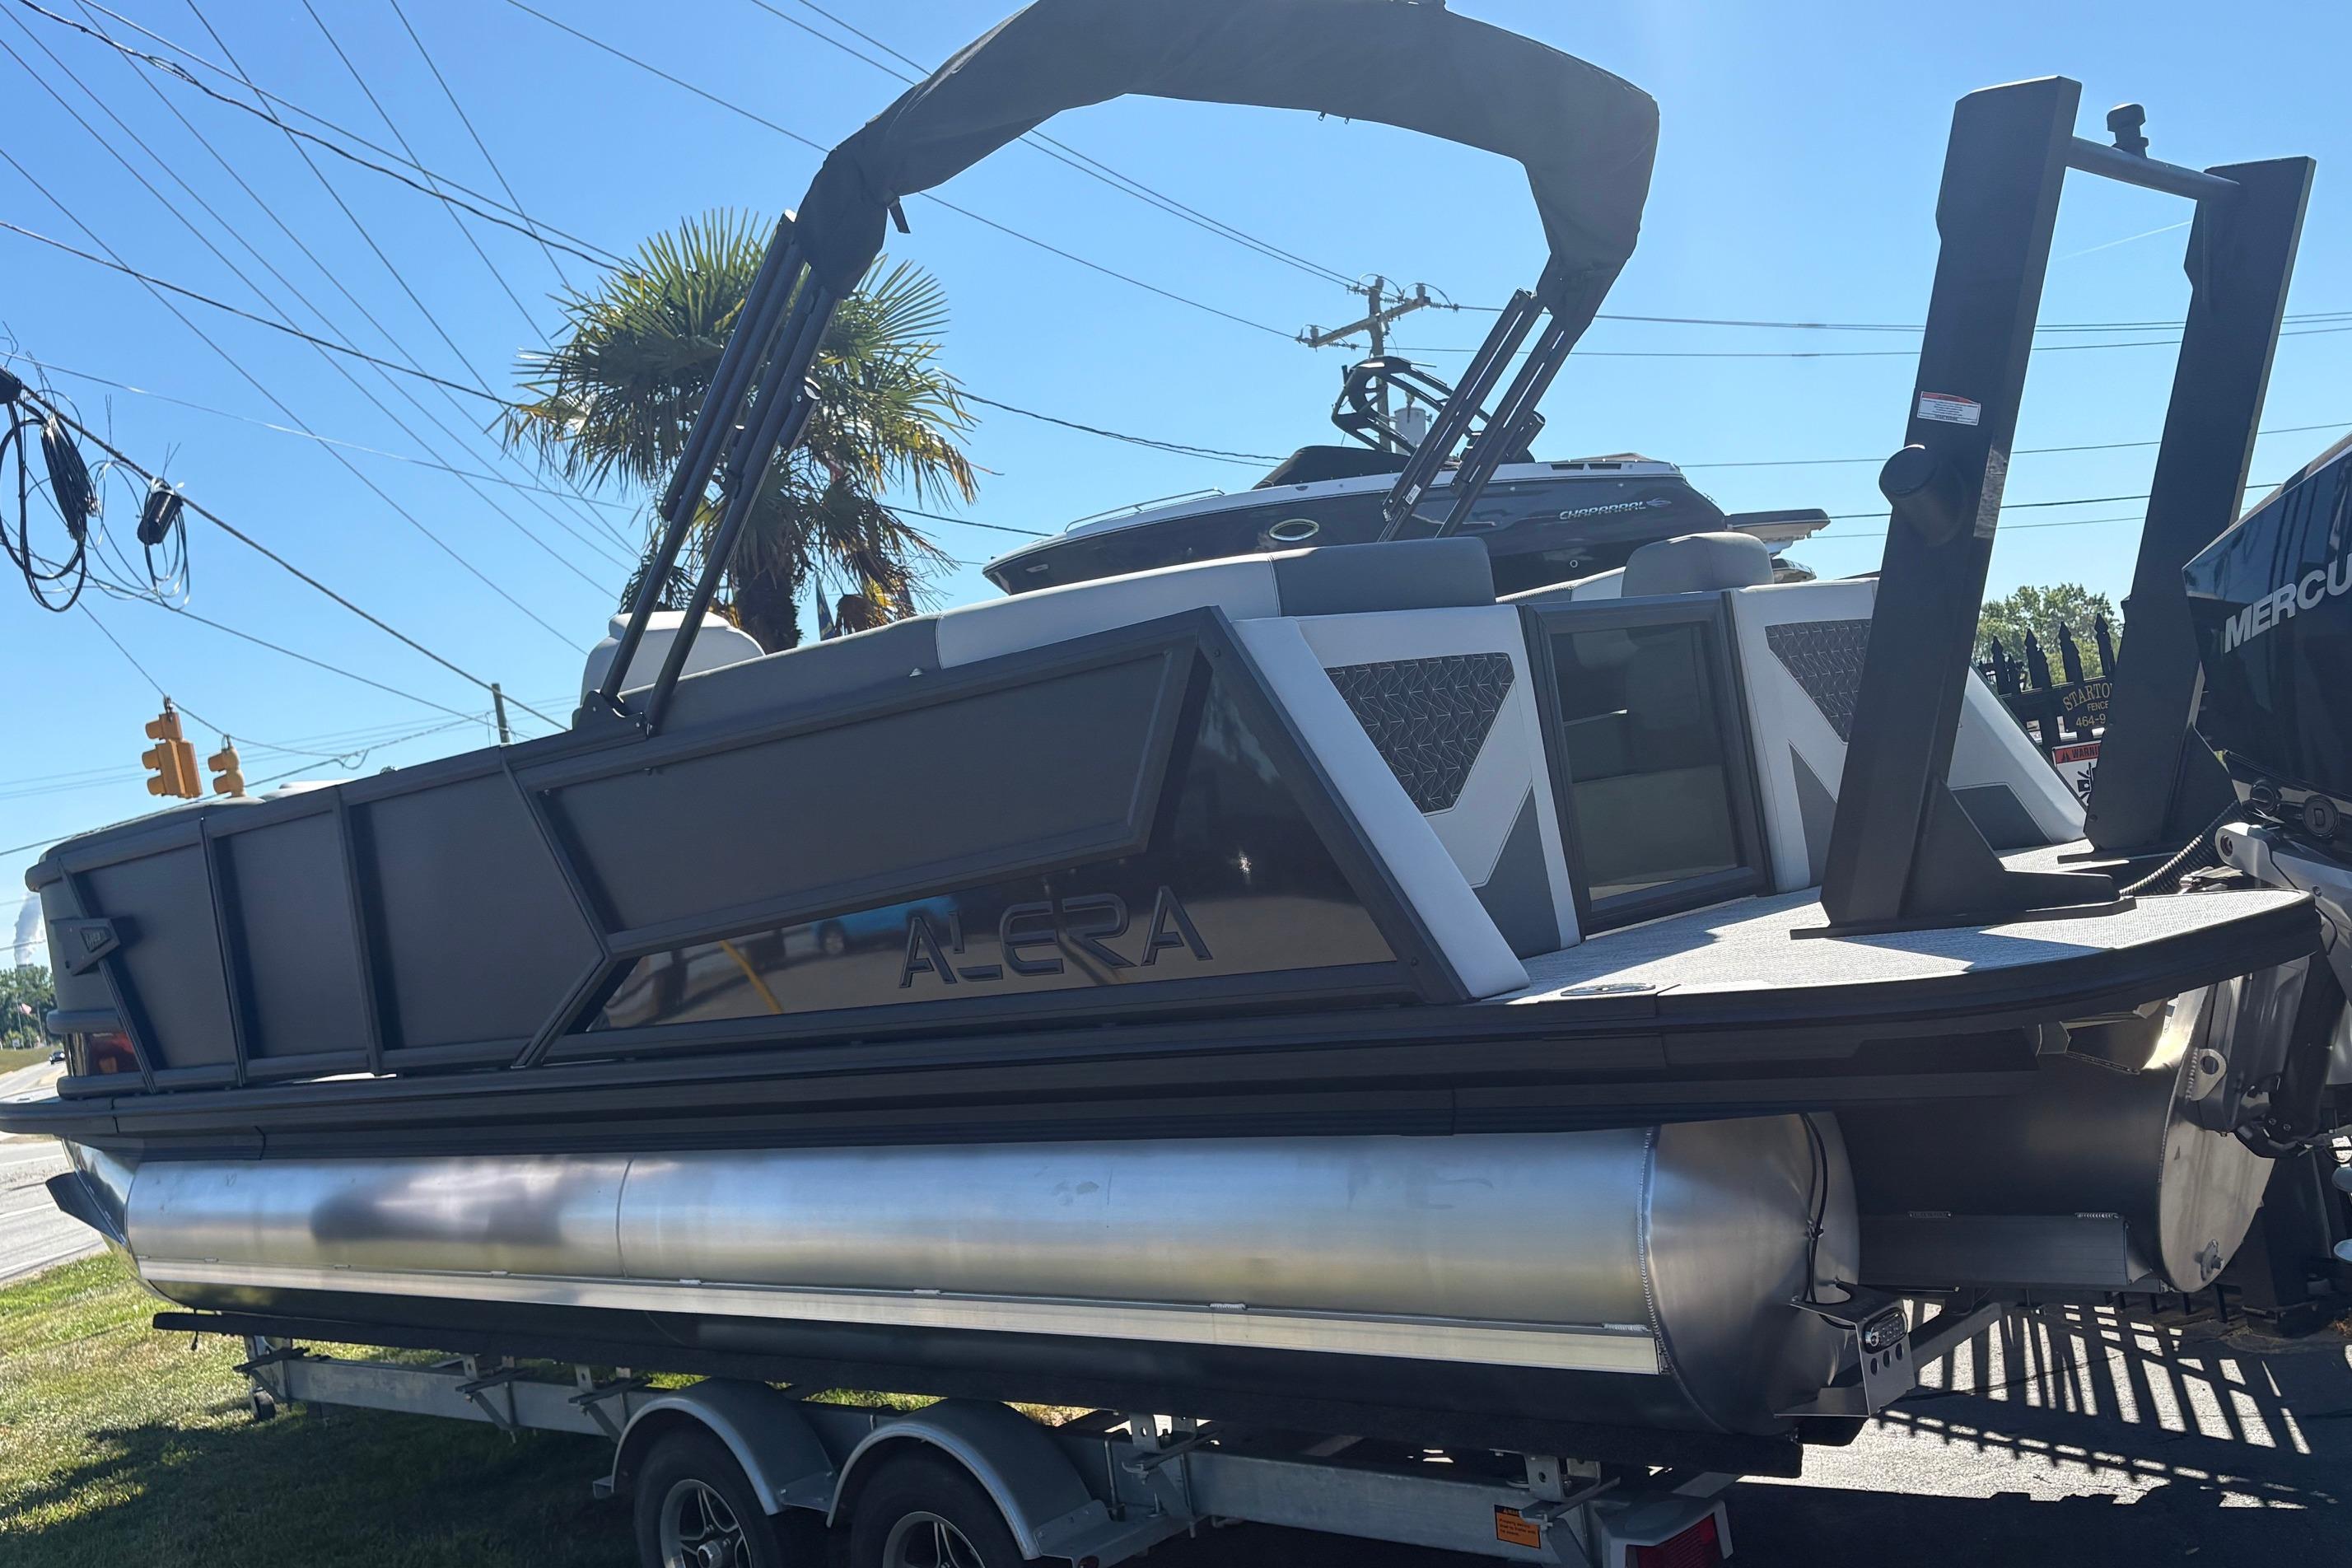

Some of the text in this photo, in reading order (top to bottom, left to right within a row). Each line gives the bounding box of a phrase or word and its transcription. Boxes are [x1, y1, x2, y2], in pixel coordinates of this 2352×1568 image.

[2062, 682, 2113, 712] STARTO
[2072, 744, 2100, 758] WARNI
[898, 885, 1213, 989] ALERA
